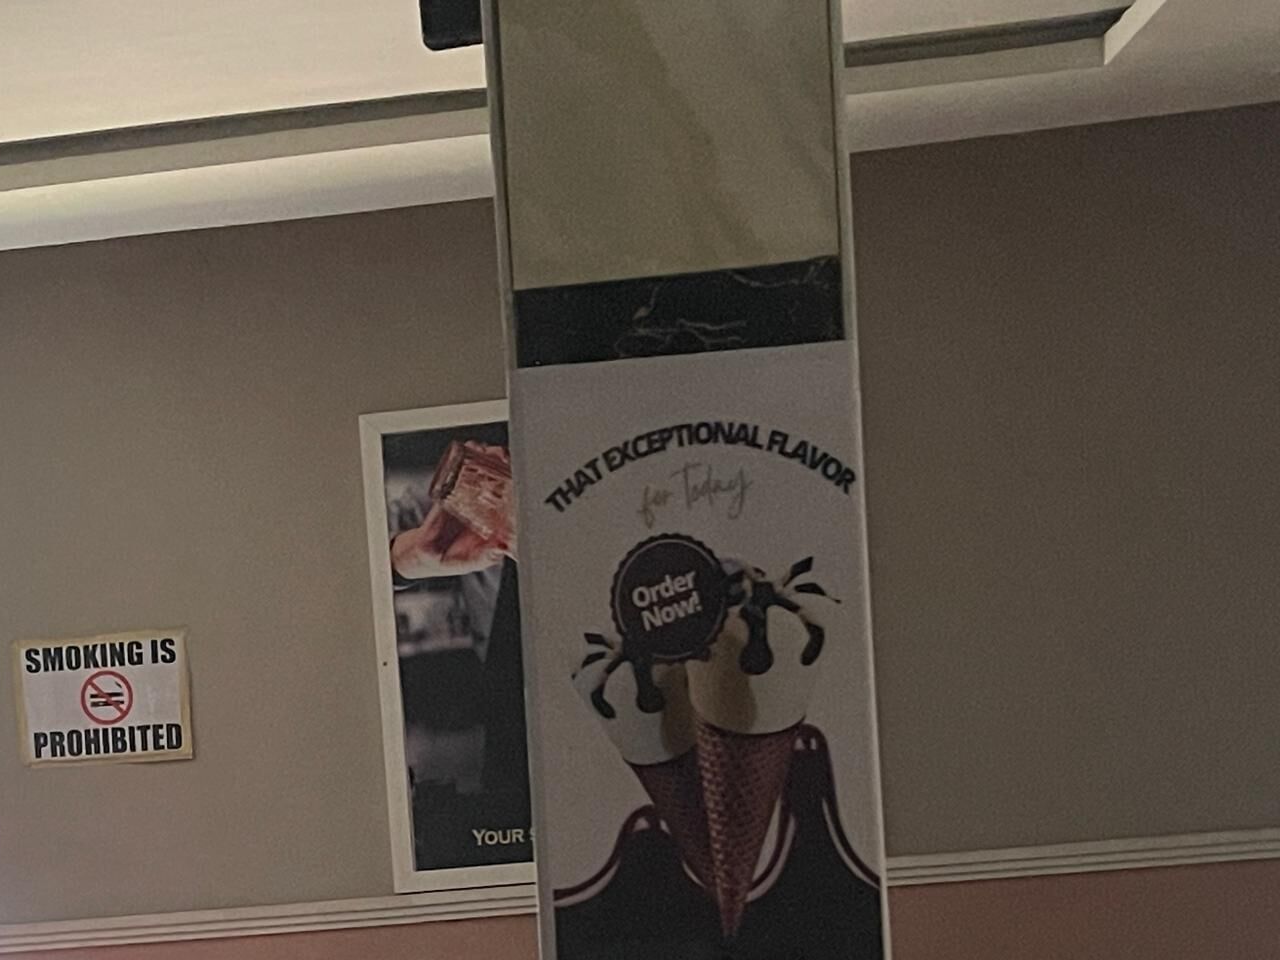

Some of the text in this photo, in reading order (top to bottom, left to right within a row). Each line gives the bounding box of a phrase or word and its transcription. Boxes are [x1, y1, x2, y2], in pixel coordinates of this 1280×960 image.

[543, 421, 857, 513] THAT EXCEPTIONAL FLAVOR
[631, 570, 697, 609] Order
[640, 591, 704, 632] Now!
[25, 638, 176, 674] SMOKING IS
[33, 723, 183, 759] PROHIBITED
[472, 829, 525, 846] YOUR
